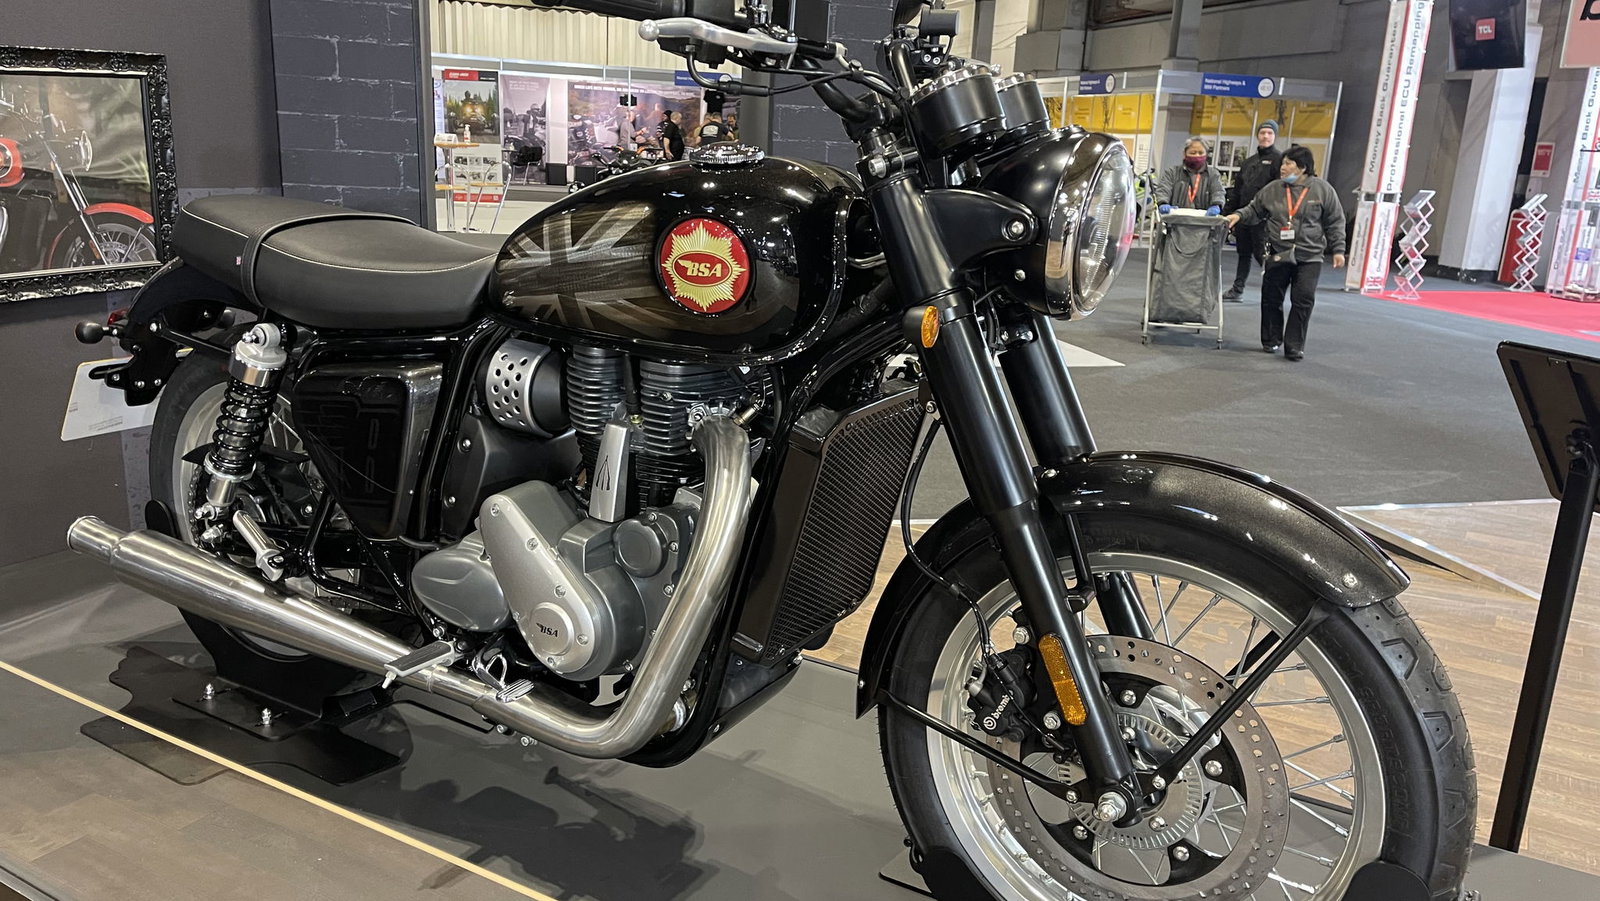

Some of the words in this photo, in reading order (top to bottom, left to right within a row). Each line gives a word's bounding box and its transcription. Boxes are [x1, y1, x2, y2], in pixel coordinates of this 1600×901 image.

[1405, 2, 1425, 75] Remapping
[1479, 25, 1492, 34] TCL
[1369, 131, 1381, 172] Money
[1376, 96, 1386, 127] Back
[1382, 22, 1398, 92] Guarantee
[1401, 79, 1411, 107] ECU
[1581, 111, 1592, 140] Back
[1588, 66, 1600, 107] Guara
[1386, 111, 1405, 191] Professional
[685, 261, 722, 277] BSA
[539, 624, 558, 637] BSA
